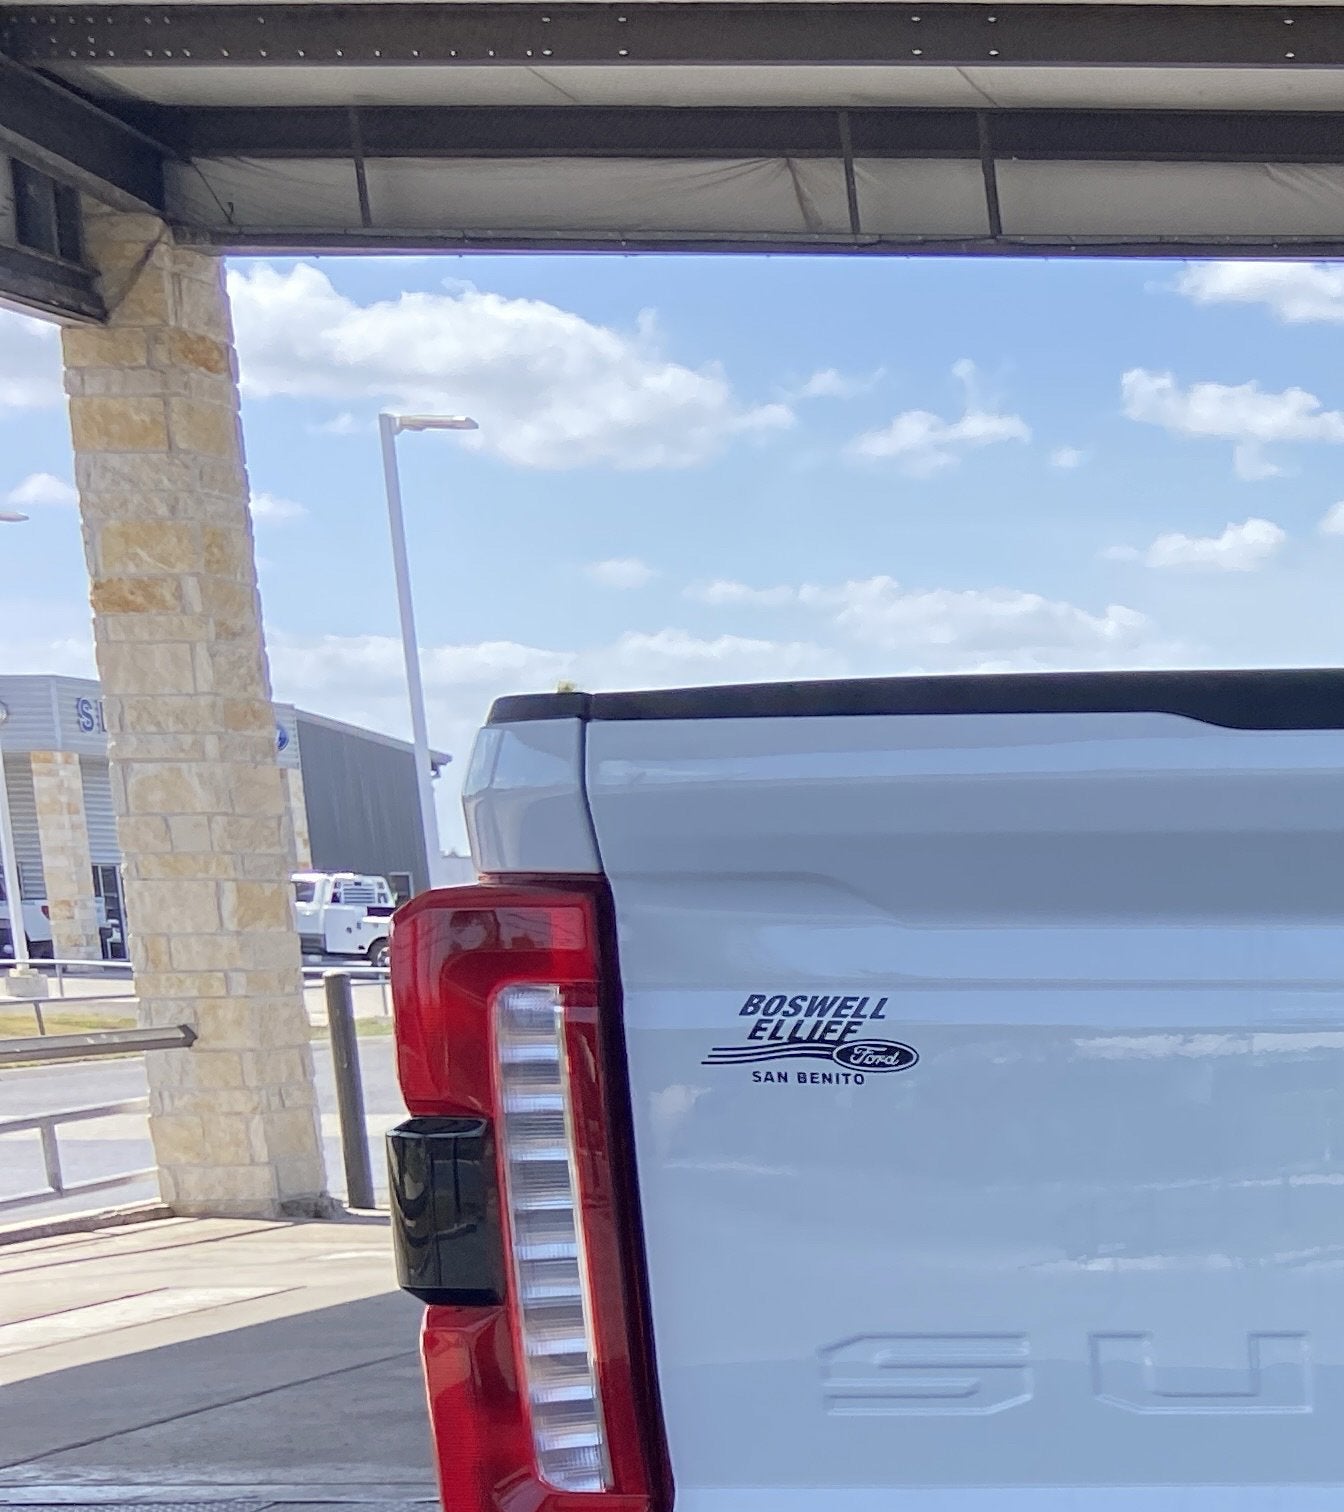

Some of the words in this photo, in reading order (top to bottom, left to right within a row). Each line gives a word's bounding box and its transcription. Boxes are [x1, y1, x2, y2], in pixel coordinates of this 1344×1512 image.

[739, 994, 888, 1020] BOSWELL
[747, 1020, 863, 1042] ELLIFF
[850, 1045, 900, 1066] Ford
[752, 1071, 788, 1083] SAN
[797, 1072, 865, 1085] BENITO
